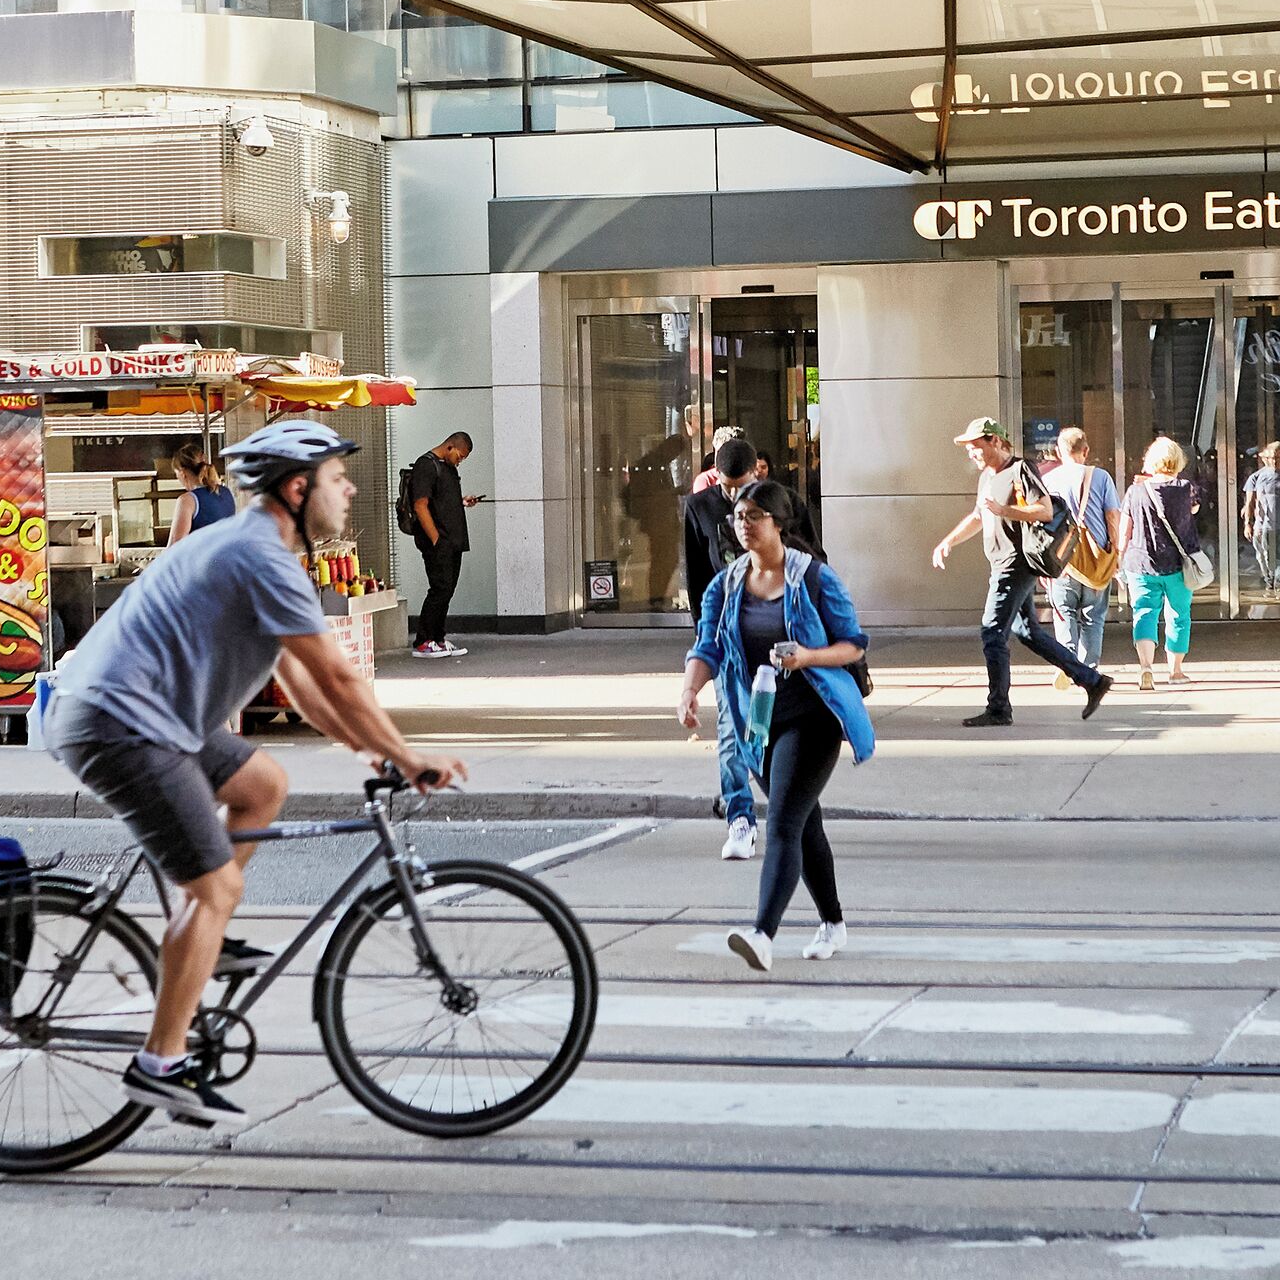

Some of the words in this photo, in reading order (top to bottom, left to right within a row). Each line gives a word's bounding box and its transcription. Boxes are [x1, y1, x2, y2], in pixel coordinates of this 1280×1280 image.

[913, 199, 992, 240] CF
[1001, 196, 1188, 239] Toronto
[28, 359, 43, 378] &
[51, 357, 102, 377] COLD
[110, 354, 186, 376] DRINKS
